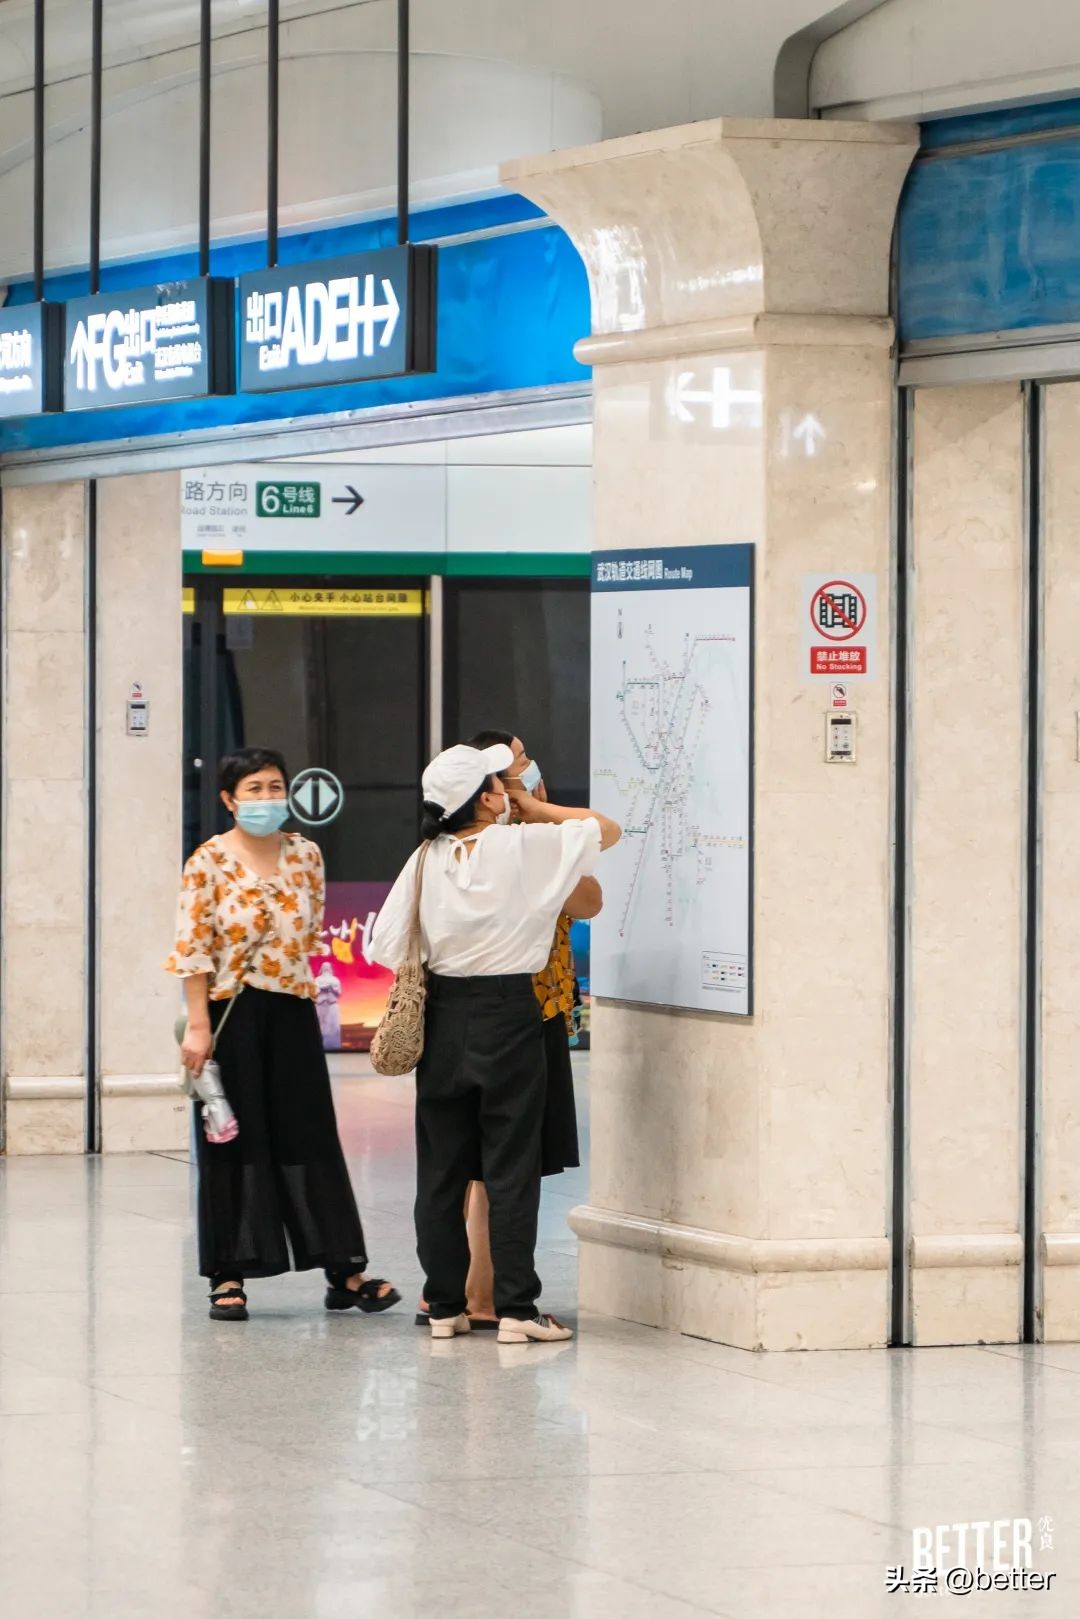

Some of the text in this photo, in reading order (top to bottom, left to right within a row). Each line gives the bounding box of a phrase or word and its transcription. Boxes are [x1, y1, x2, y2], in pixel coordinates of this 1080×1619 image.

[246, 274, 374, 365] 出口 ADEH
[87, 310, 125, 391] FG
[124, 309, 156, 357] 出口
[184, 481, 248, 502] 路方向
[209, 505, 248, 516] Station
[681, 566, 693, 581] Map
[816, 650, 861, 661] 禁止堆放
